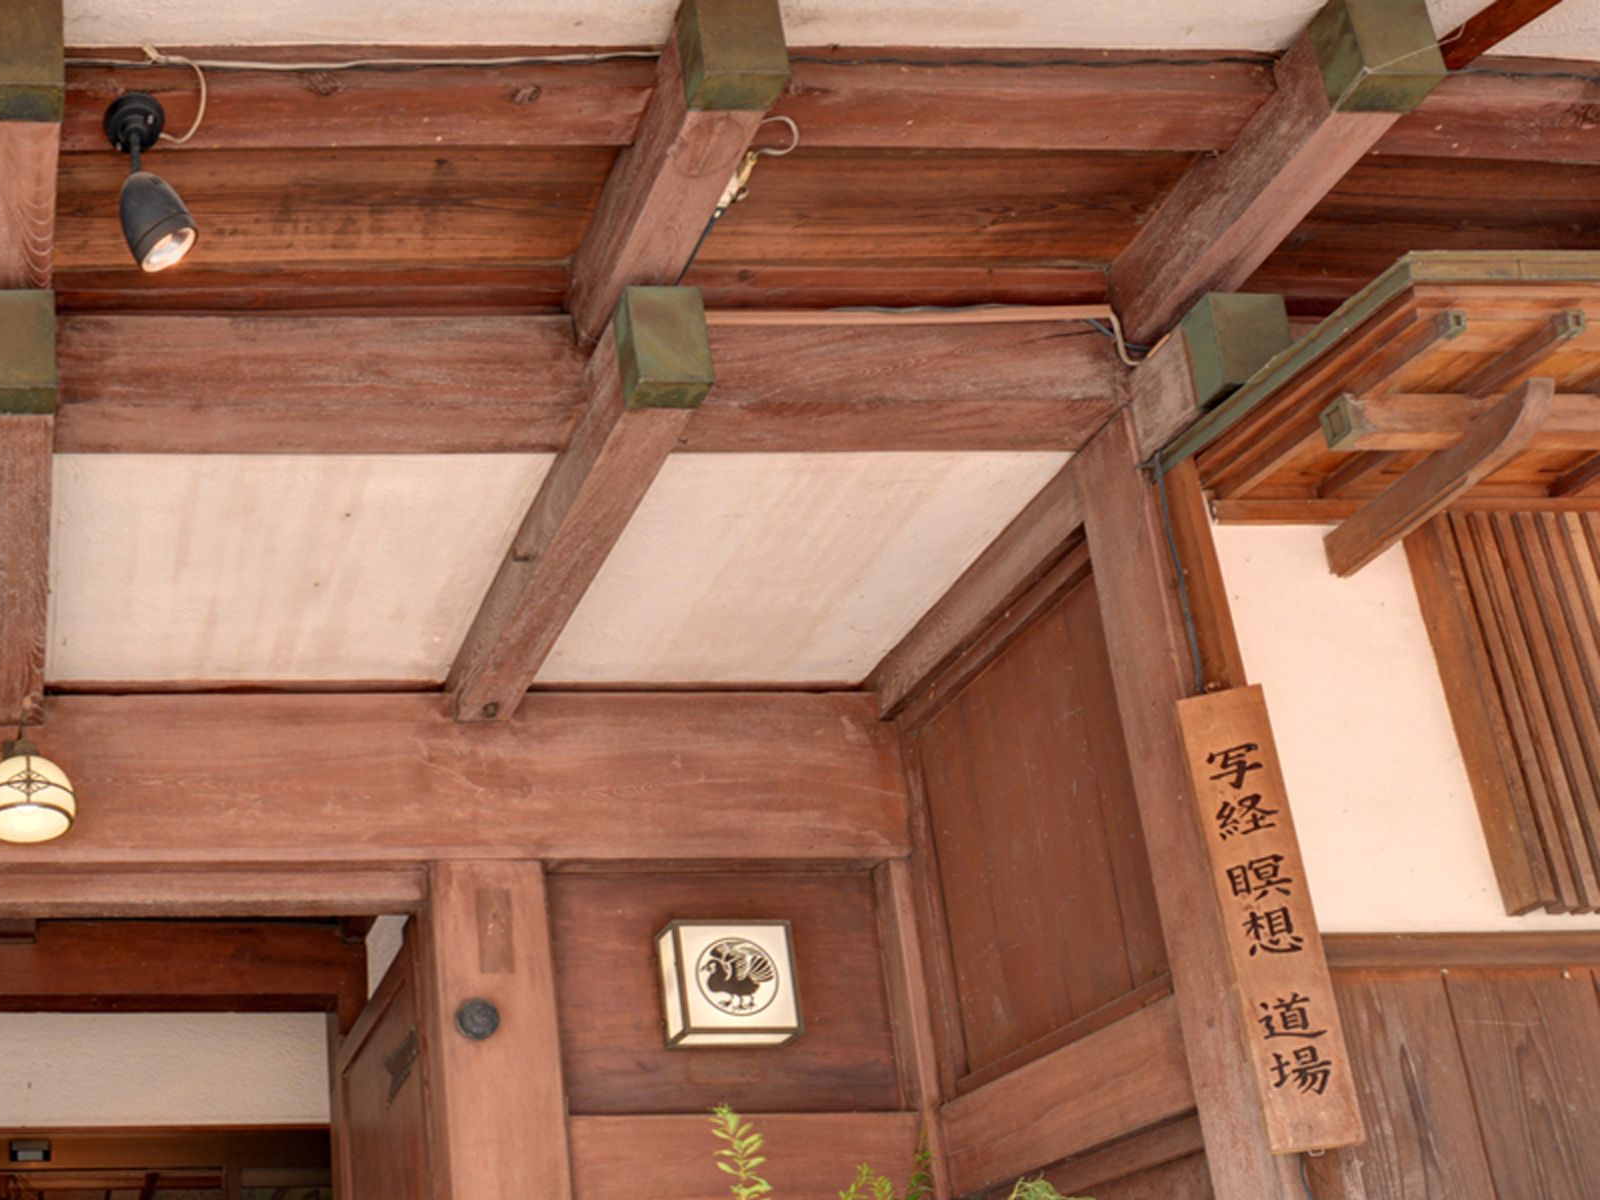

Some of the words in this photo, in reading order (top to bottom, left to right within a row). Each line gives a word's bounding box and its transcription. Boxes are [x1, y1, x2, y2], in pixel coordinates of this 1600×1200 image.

[1206, 742, 1333, 1096] 写経瞑想道場
